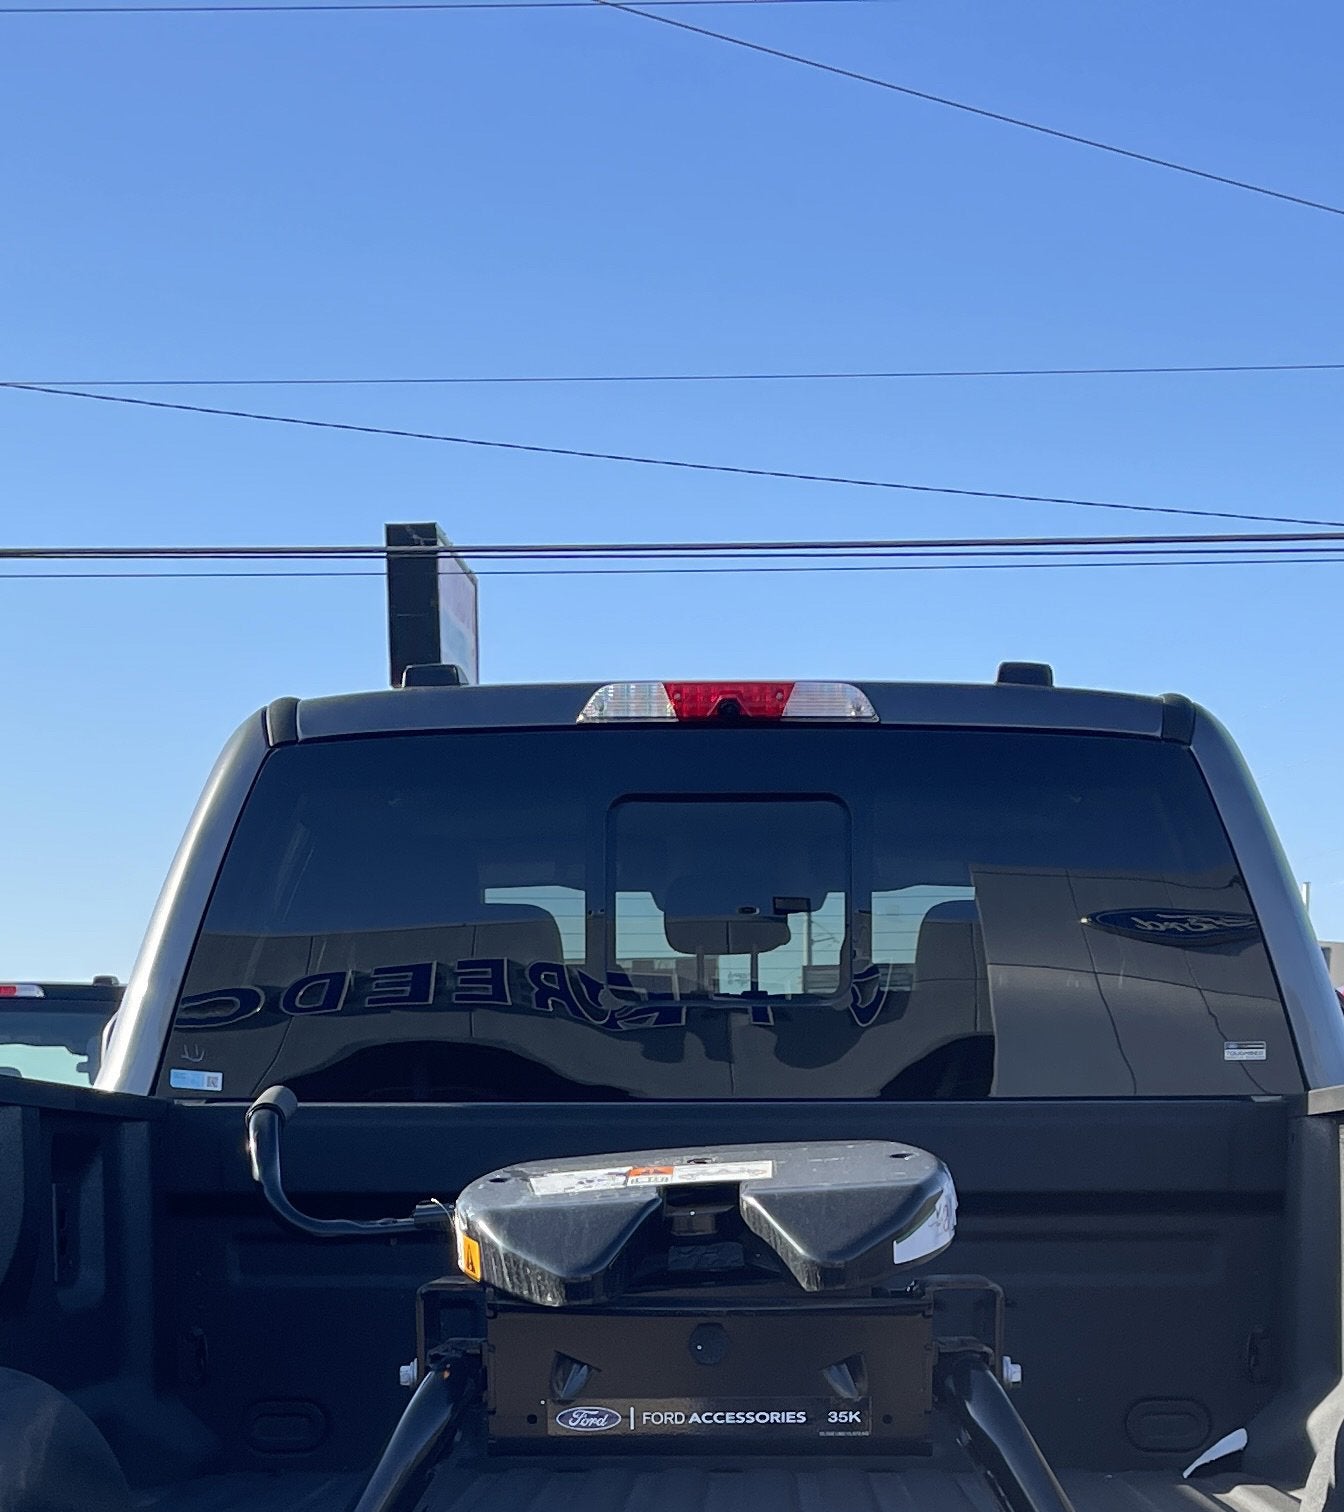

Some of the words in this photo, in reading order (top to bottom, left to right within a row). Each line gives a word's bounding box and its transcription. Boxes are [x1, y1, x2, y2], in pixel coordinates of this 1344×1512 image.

[568, 1409, 609, 1427] Ford
[642, 1411, 686, 1425] FORD
[688, 1411, 807, 1424] ACCESSORIES
[827, 1411, 862, 1423] 35K
